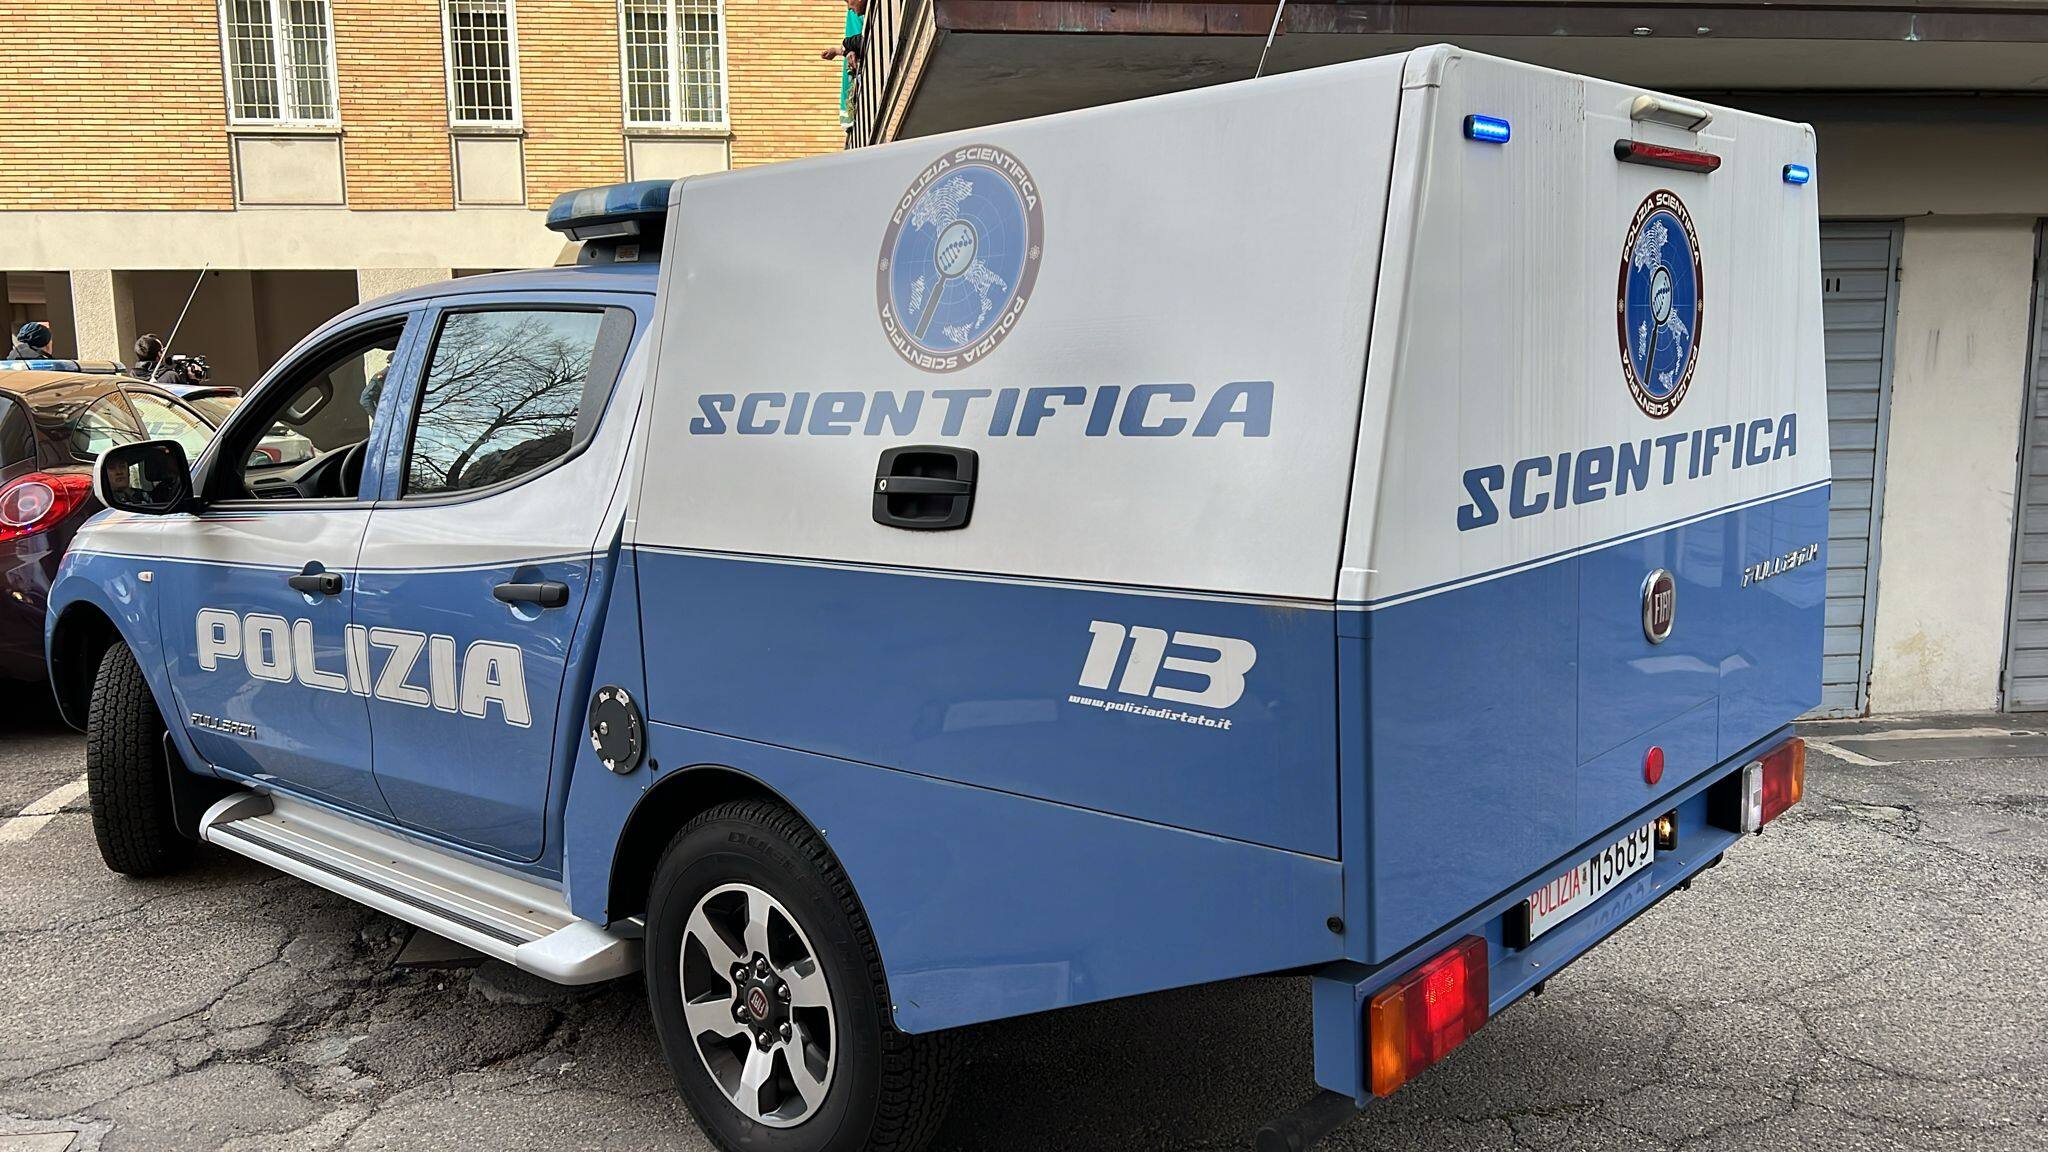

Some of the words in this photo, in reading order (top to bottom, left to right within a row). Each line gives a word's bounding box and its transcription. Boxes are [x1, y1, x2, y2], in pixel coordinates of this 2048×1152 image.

[892, 158, 951, 225] POLIZIA
[954, 147, 1038, 212] SCIENTIFICA
[1623, 198, 1654, 263] POLIZIA
[1656, 193, 1700, 266] SCIENTIFICA
[881, 302, 958, 370] SCIENTIFICA
[963, 295, 1025, 363] POLIZIA
[1654, 589, 1673, 626] FIAT
[196, 607, 532, 729] POLIZIA
[1078, 620, 1257, 710] 113
[1068, 694, 1233, 730] www.poliziadistato.it
[1530, 865, 1581, 924] POLIZIA
